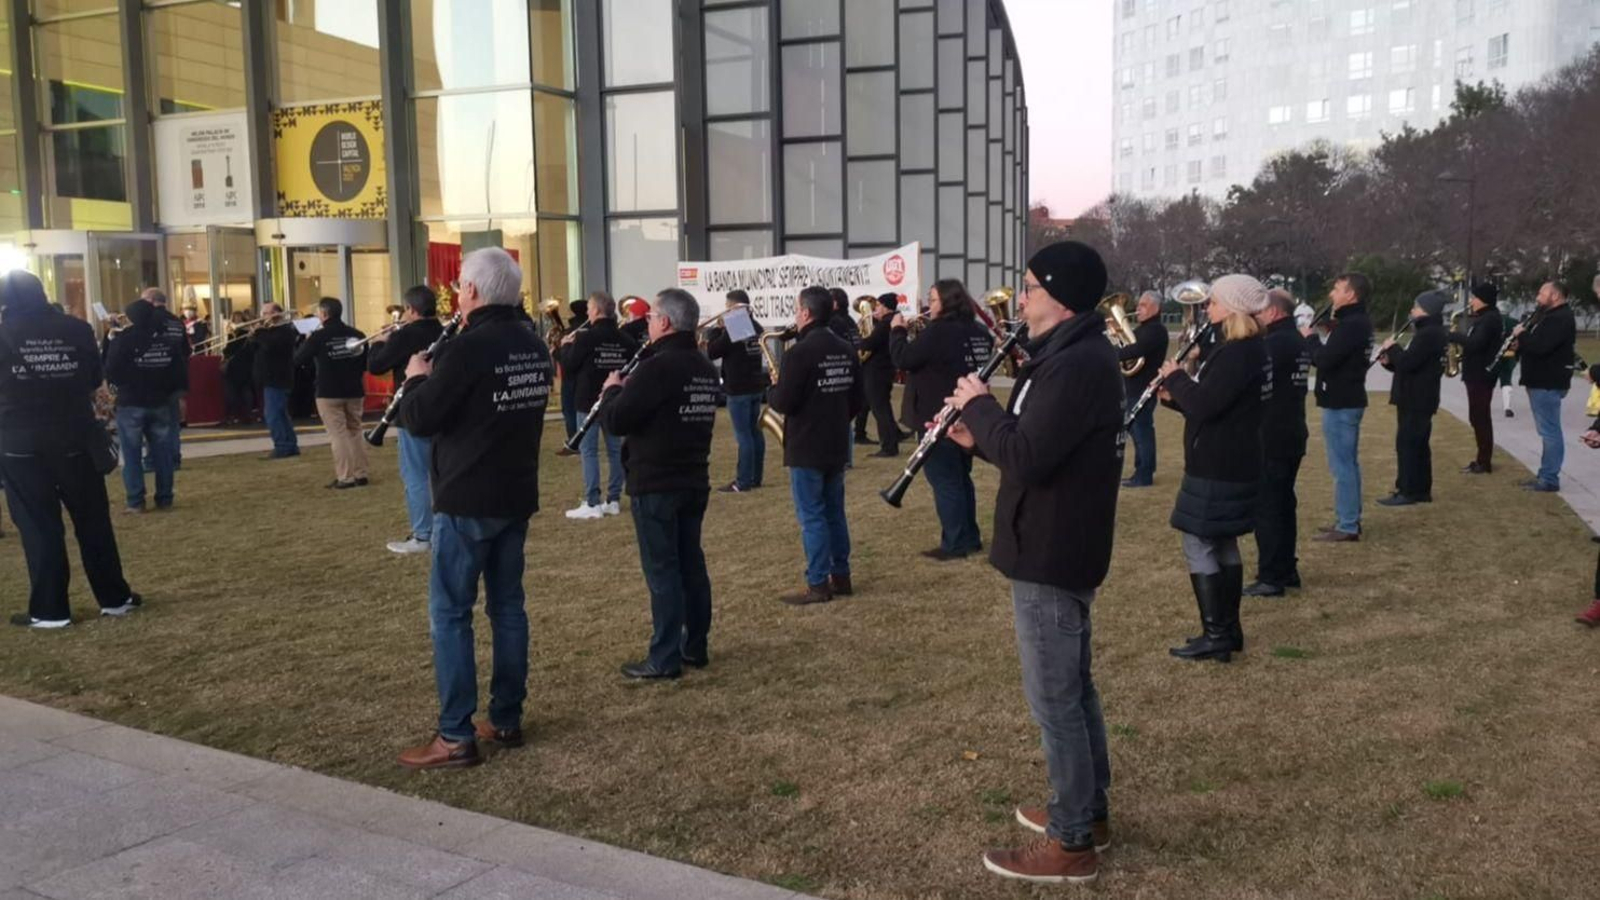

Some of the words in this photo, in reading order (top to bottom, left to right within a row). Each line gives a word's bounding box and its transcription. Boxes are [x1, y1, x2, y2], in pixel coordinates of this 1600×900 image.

[342, 149, 360, 158] CAPITAL
[713, 270, 737, 291] BANDA
[780, 264, 807, 288] SEMPRE
[754, 296, 769, 318] SEU
[23, 353, 60, 362] SEMPRE
[62, 353, 70, 361] A
[504, 363, 524, 373] Banda
[524, 361, 550, 370] Municipa
[508, 372, 538, 386] SEMPRE
[539, 372, 545, 382] A
[493, 385, 550, 402] L'AJUNTAMEN
[690, 393, 711, 403] SEMPRE
